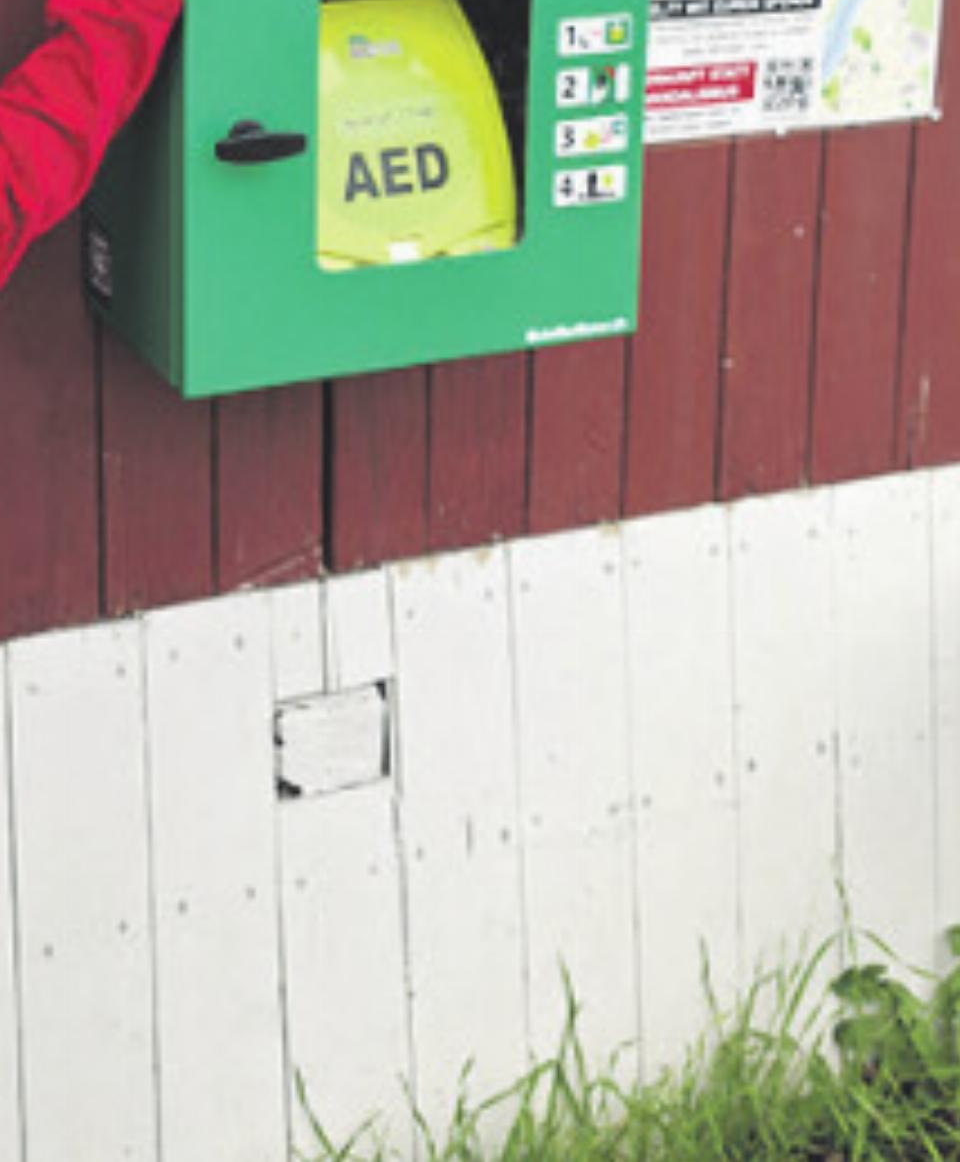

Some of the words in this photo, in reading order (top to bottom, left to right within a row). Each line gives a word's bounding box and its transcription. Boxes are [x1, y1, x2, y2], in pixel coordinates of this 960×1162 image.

[565, 25, 577, 46] 1
[561, 74, 576, 100] 2
[344, 143, 449, 202] AED
[559, 173, 574, 197] 4
